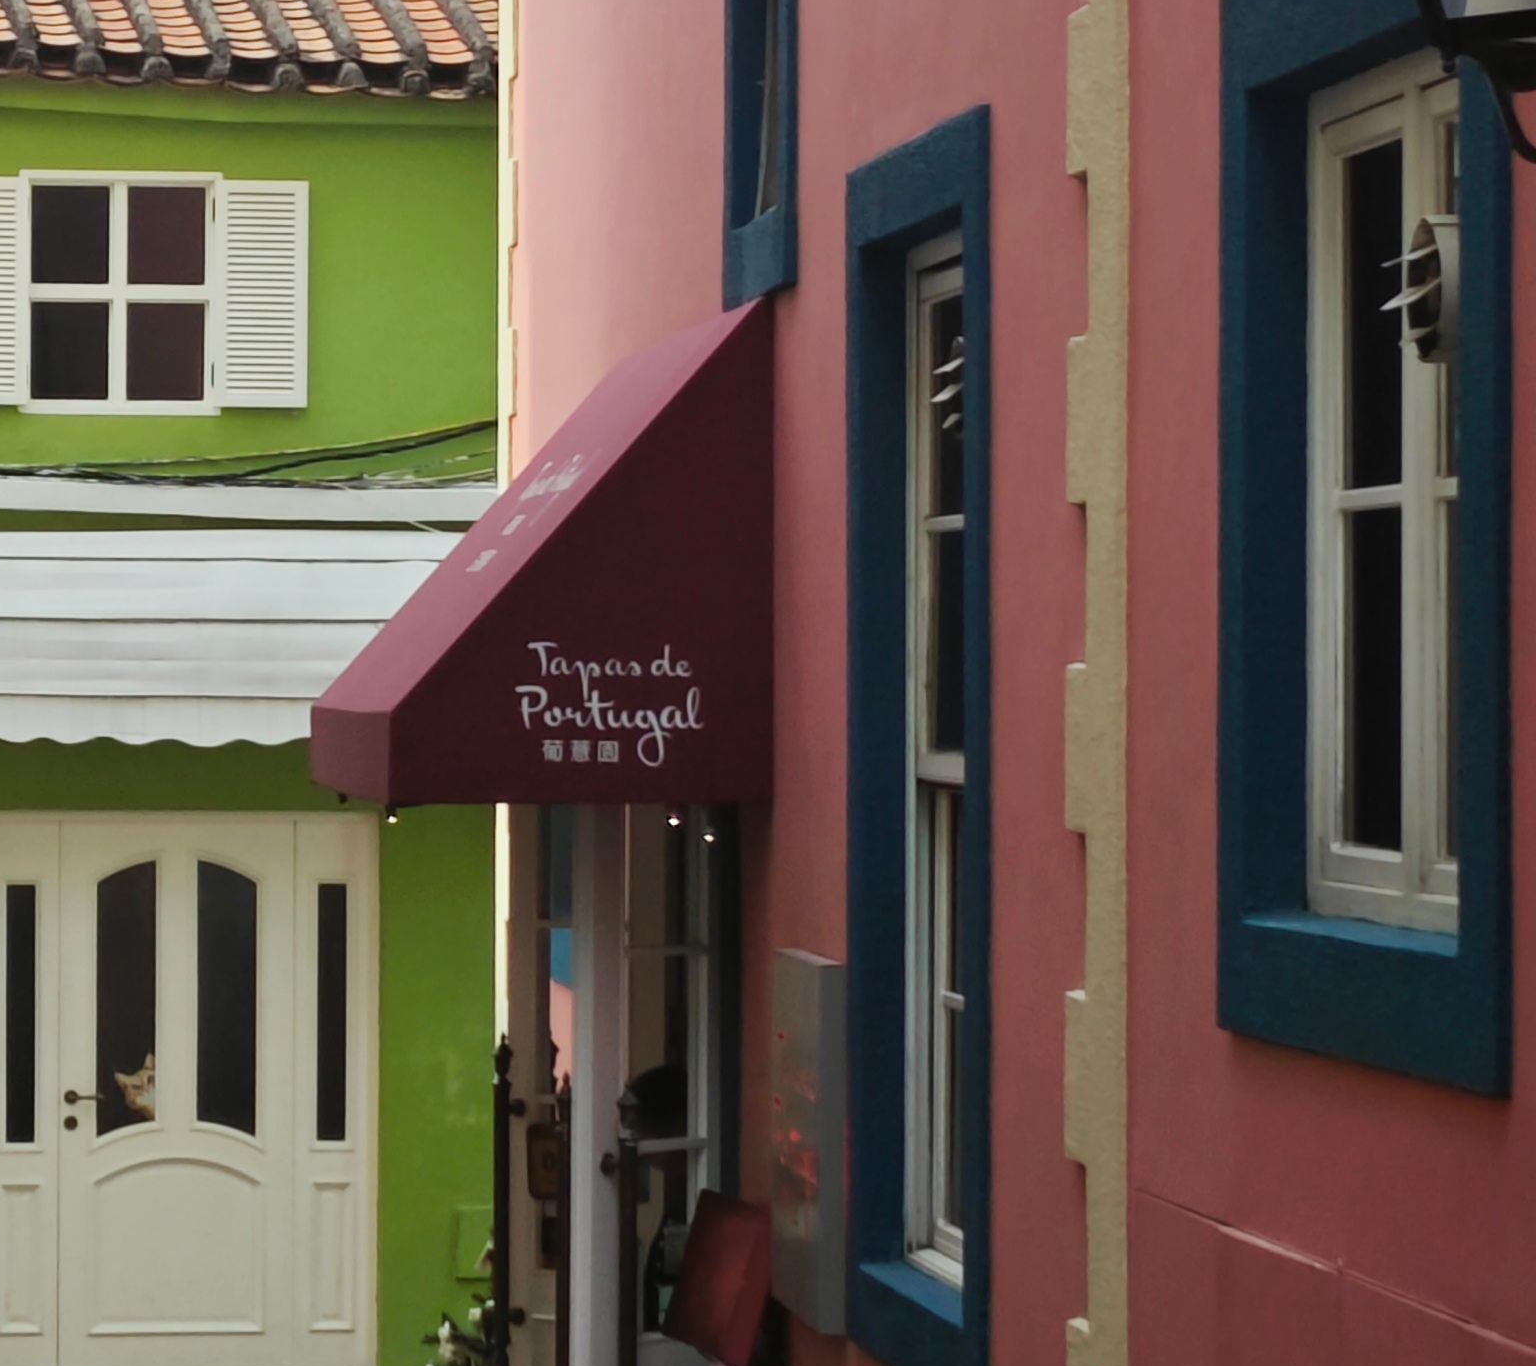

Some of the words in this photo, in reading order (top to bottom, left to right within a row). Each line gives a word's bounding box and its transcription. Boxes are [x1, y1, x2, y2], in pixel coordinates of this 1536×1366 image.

[527, 641, 642, 701] Tapas
[650, 644, 692, 677] de
[515, 686, 704, 766] Portugal
